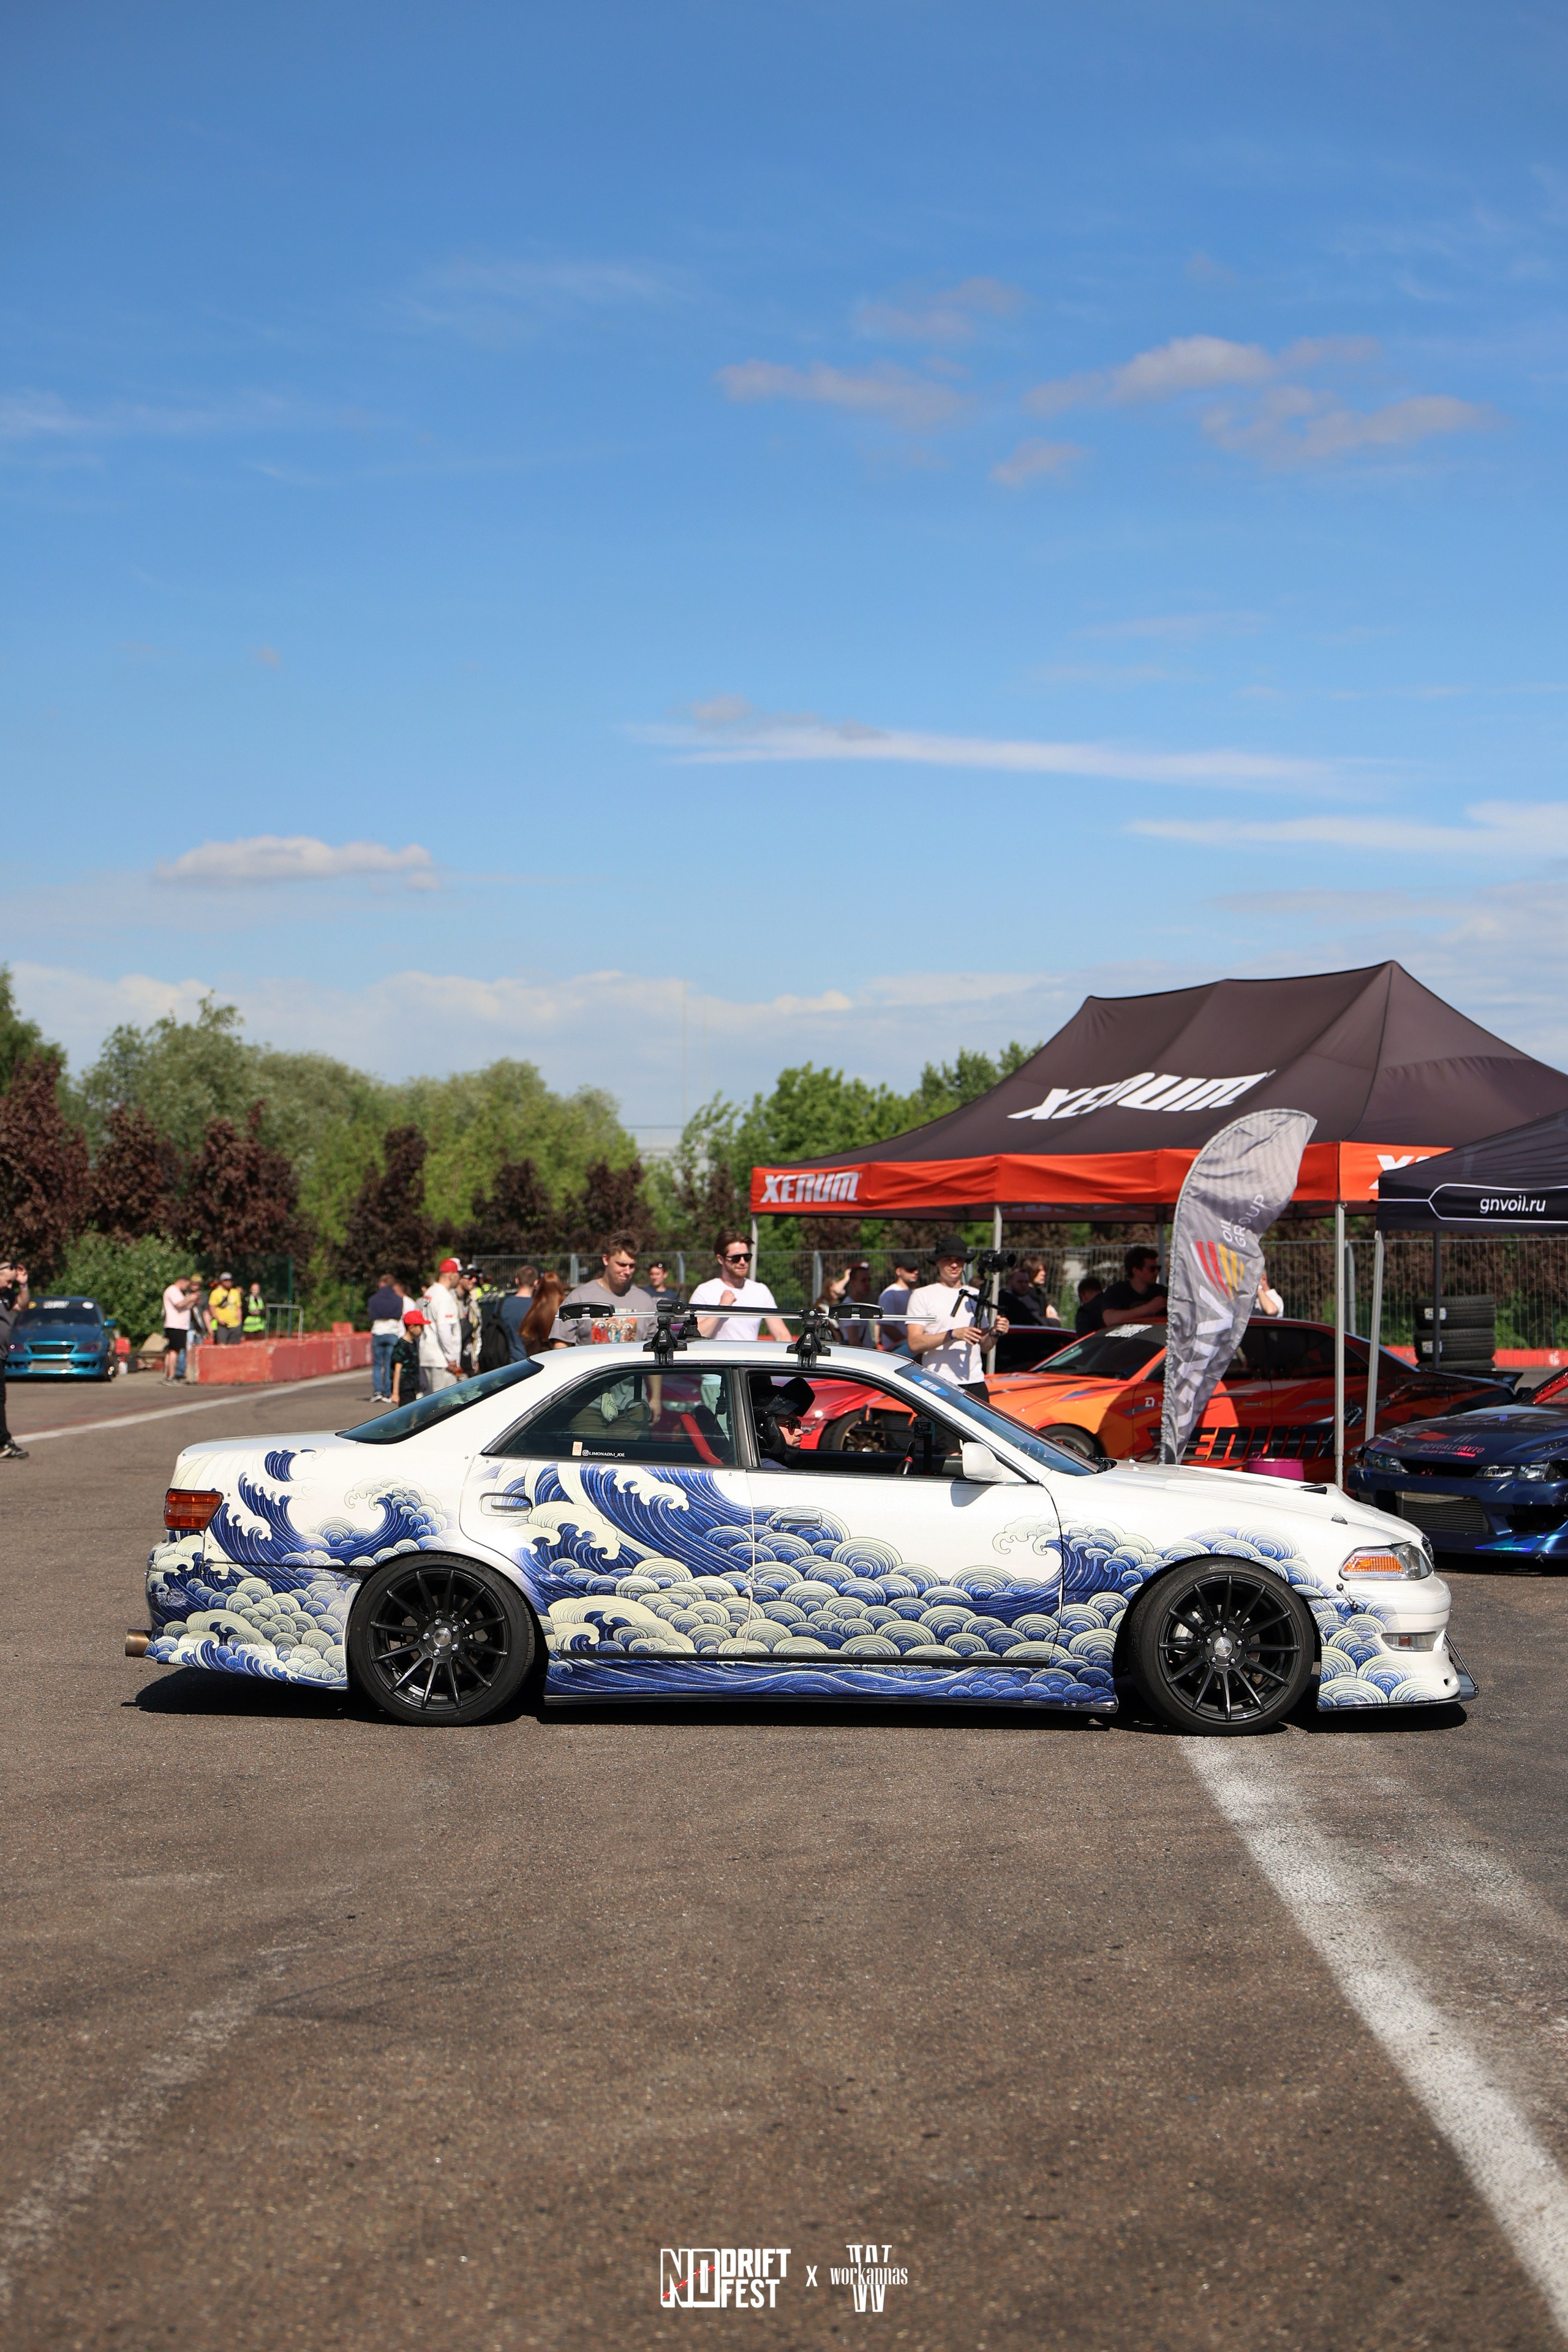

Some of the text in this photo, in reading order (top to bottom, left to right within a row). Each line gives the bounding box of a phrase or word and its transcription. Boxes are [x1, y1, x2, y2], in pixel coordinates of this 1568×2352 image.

[1007, 1072, 1268, 1120] XENUM
[760, 1172, 859, 1203] XENUM
[1480, 1195, 1546, 1214] gnvoil.ru
[1220, 1218, 1234, 1243] OIL
[1234, 1194, 1264, 1248] GROUP
